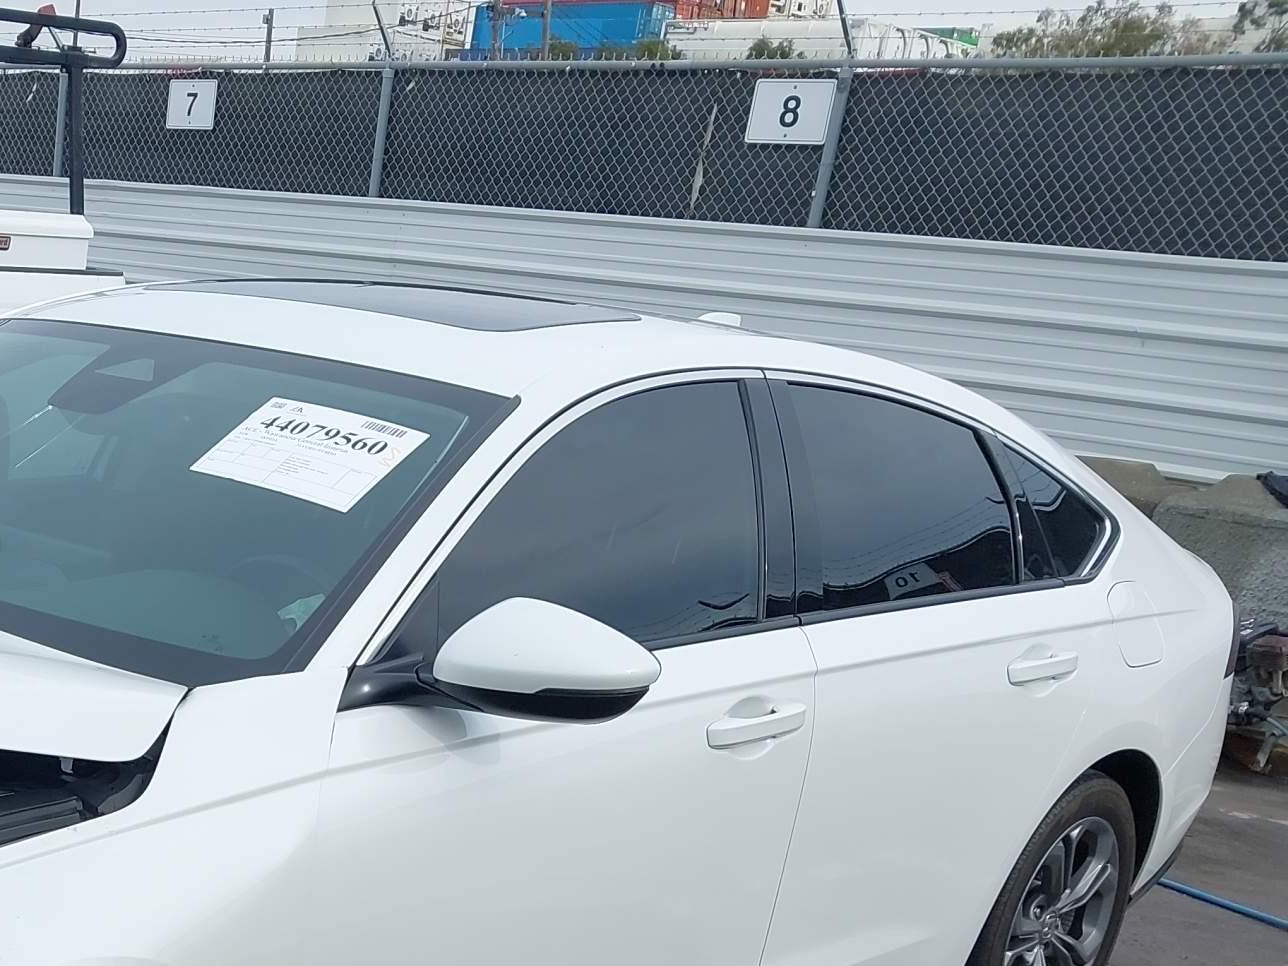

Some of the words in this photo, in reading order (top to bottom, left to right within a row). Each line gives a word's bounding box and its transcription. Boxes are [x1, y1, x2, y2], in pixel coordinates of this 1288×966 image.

[186, 92, 199, 117] 7
[779, 94, 802, 128] 8
[260, 415, 389, 456] 44079560
